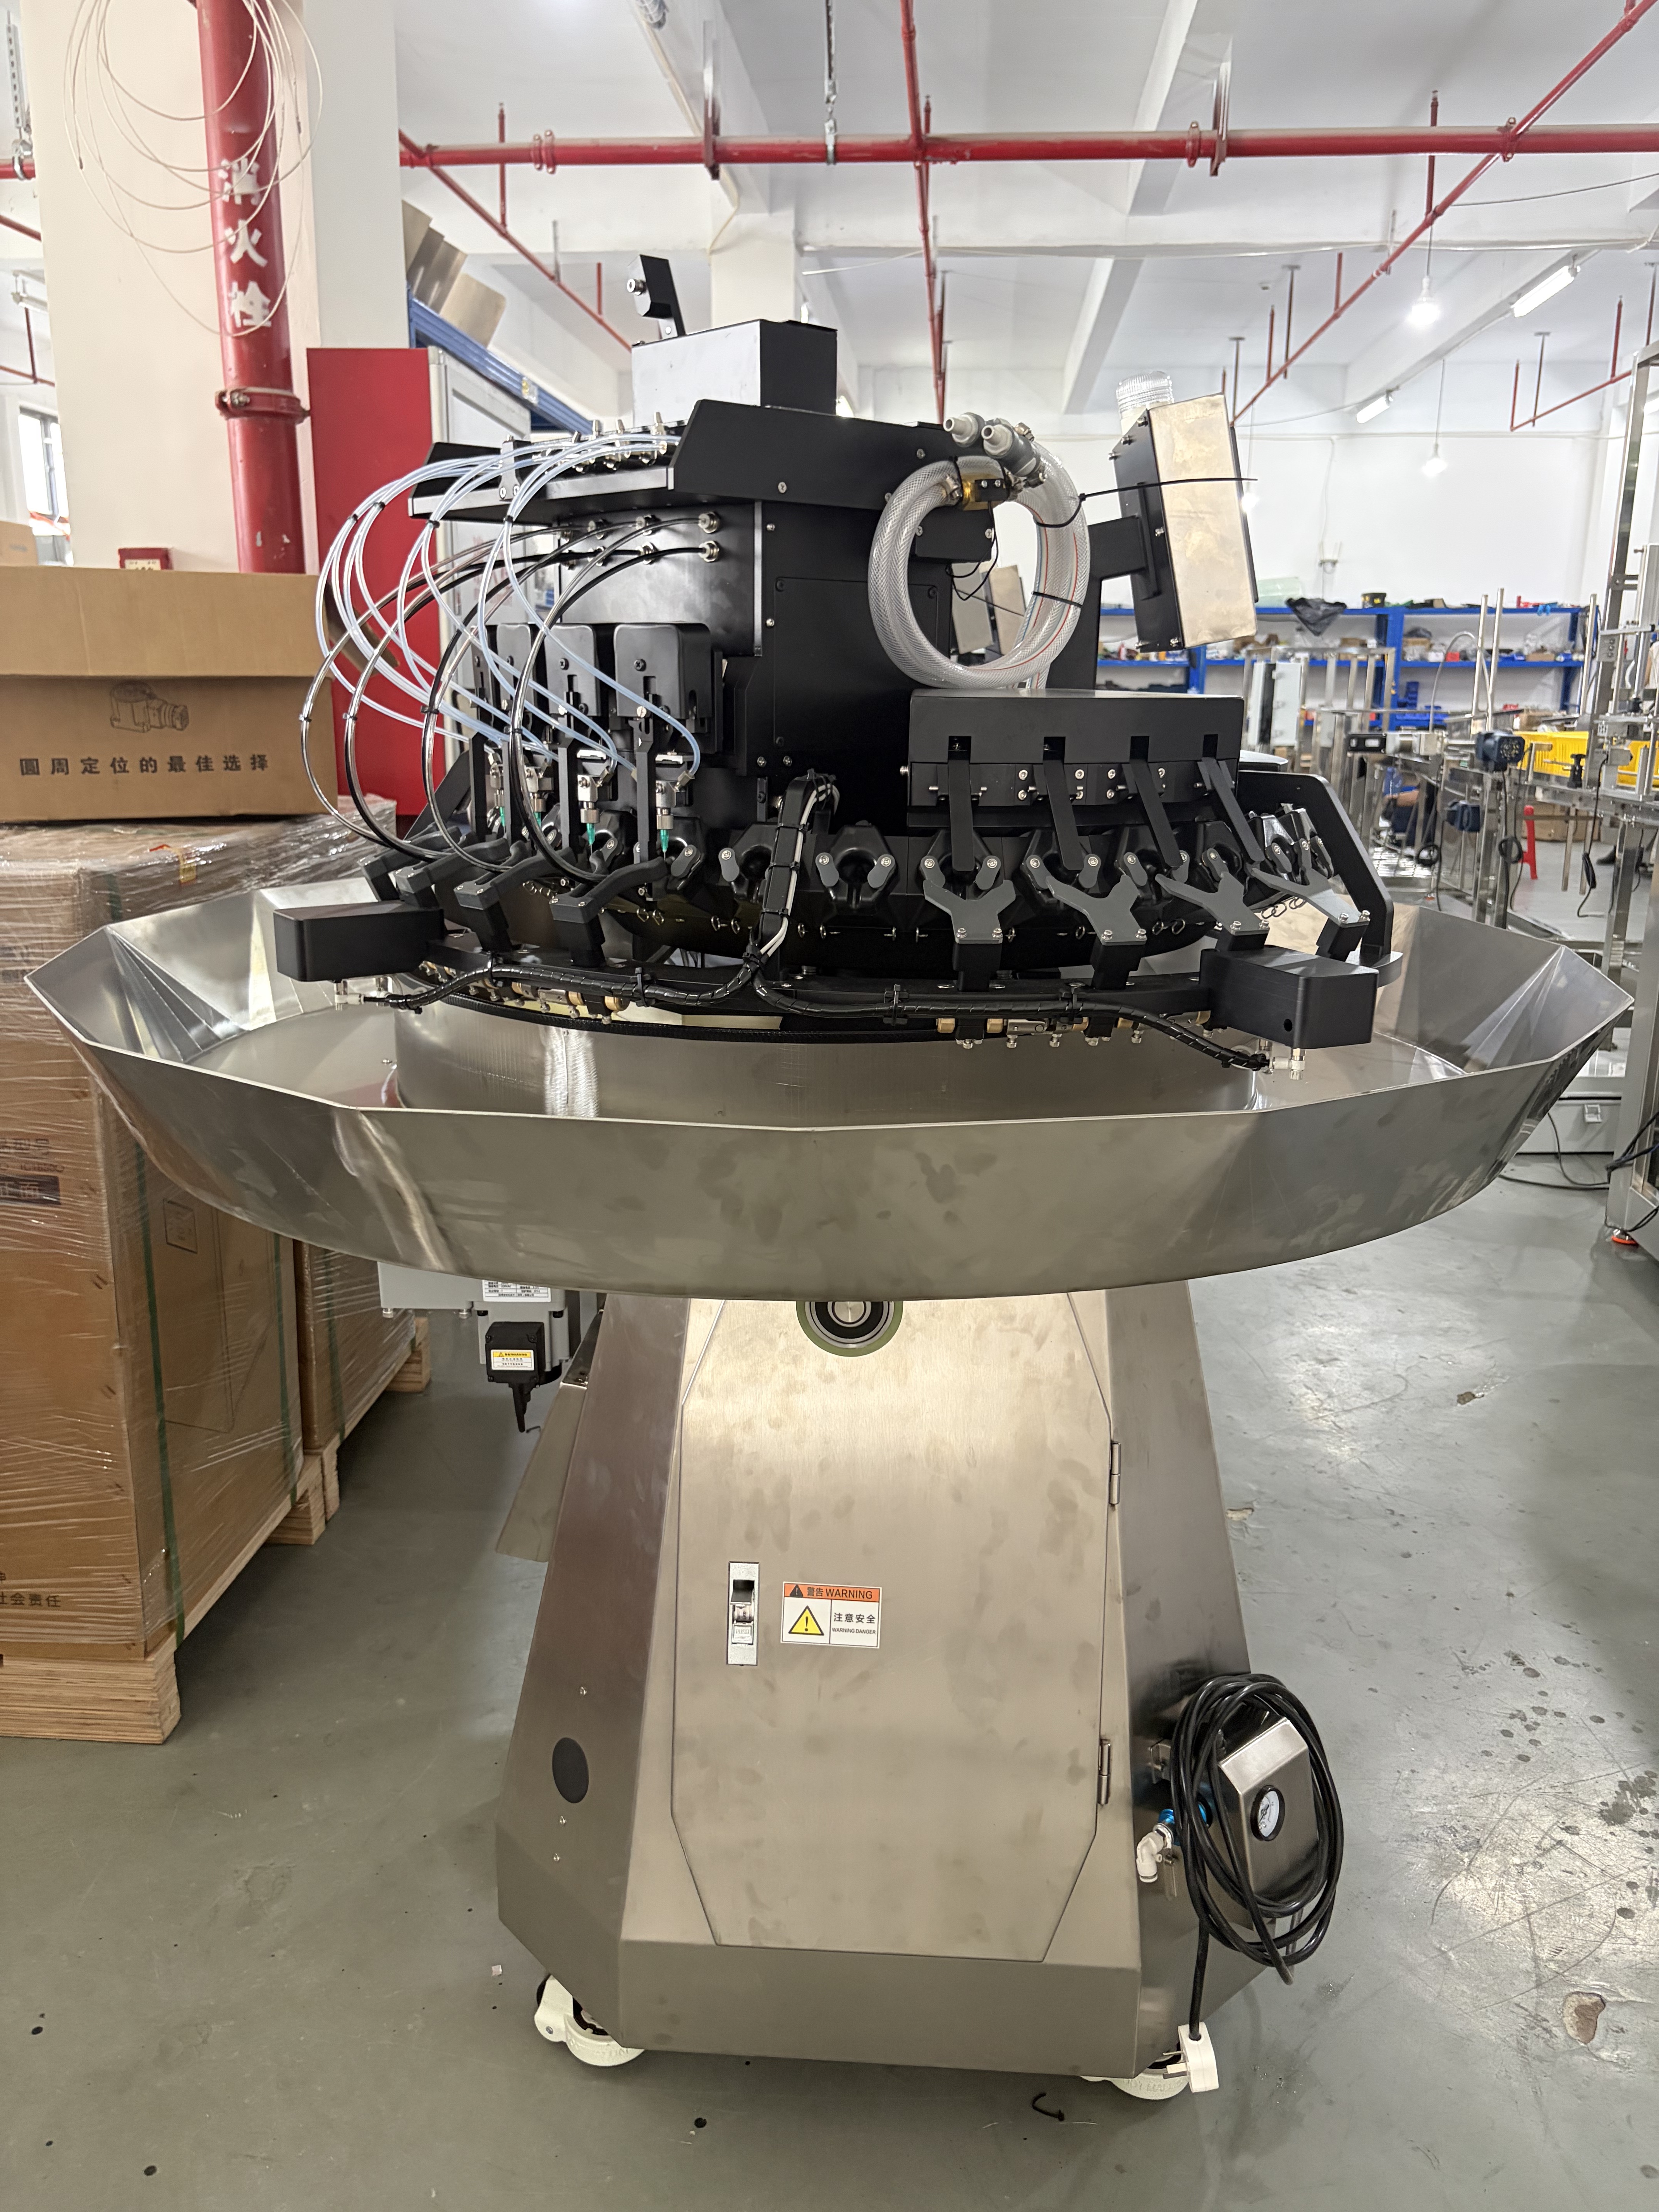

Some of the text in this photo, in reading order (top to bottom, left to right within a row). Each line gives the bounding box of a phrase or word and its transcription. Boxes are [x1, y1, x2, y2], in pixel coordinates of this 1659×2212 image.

[218, 157, 272, 328] 消火栓
[807, 1586, 873, 1599] 警告 WARNING
[833, 1612, 876, 1624] 注意安全
